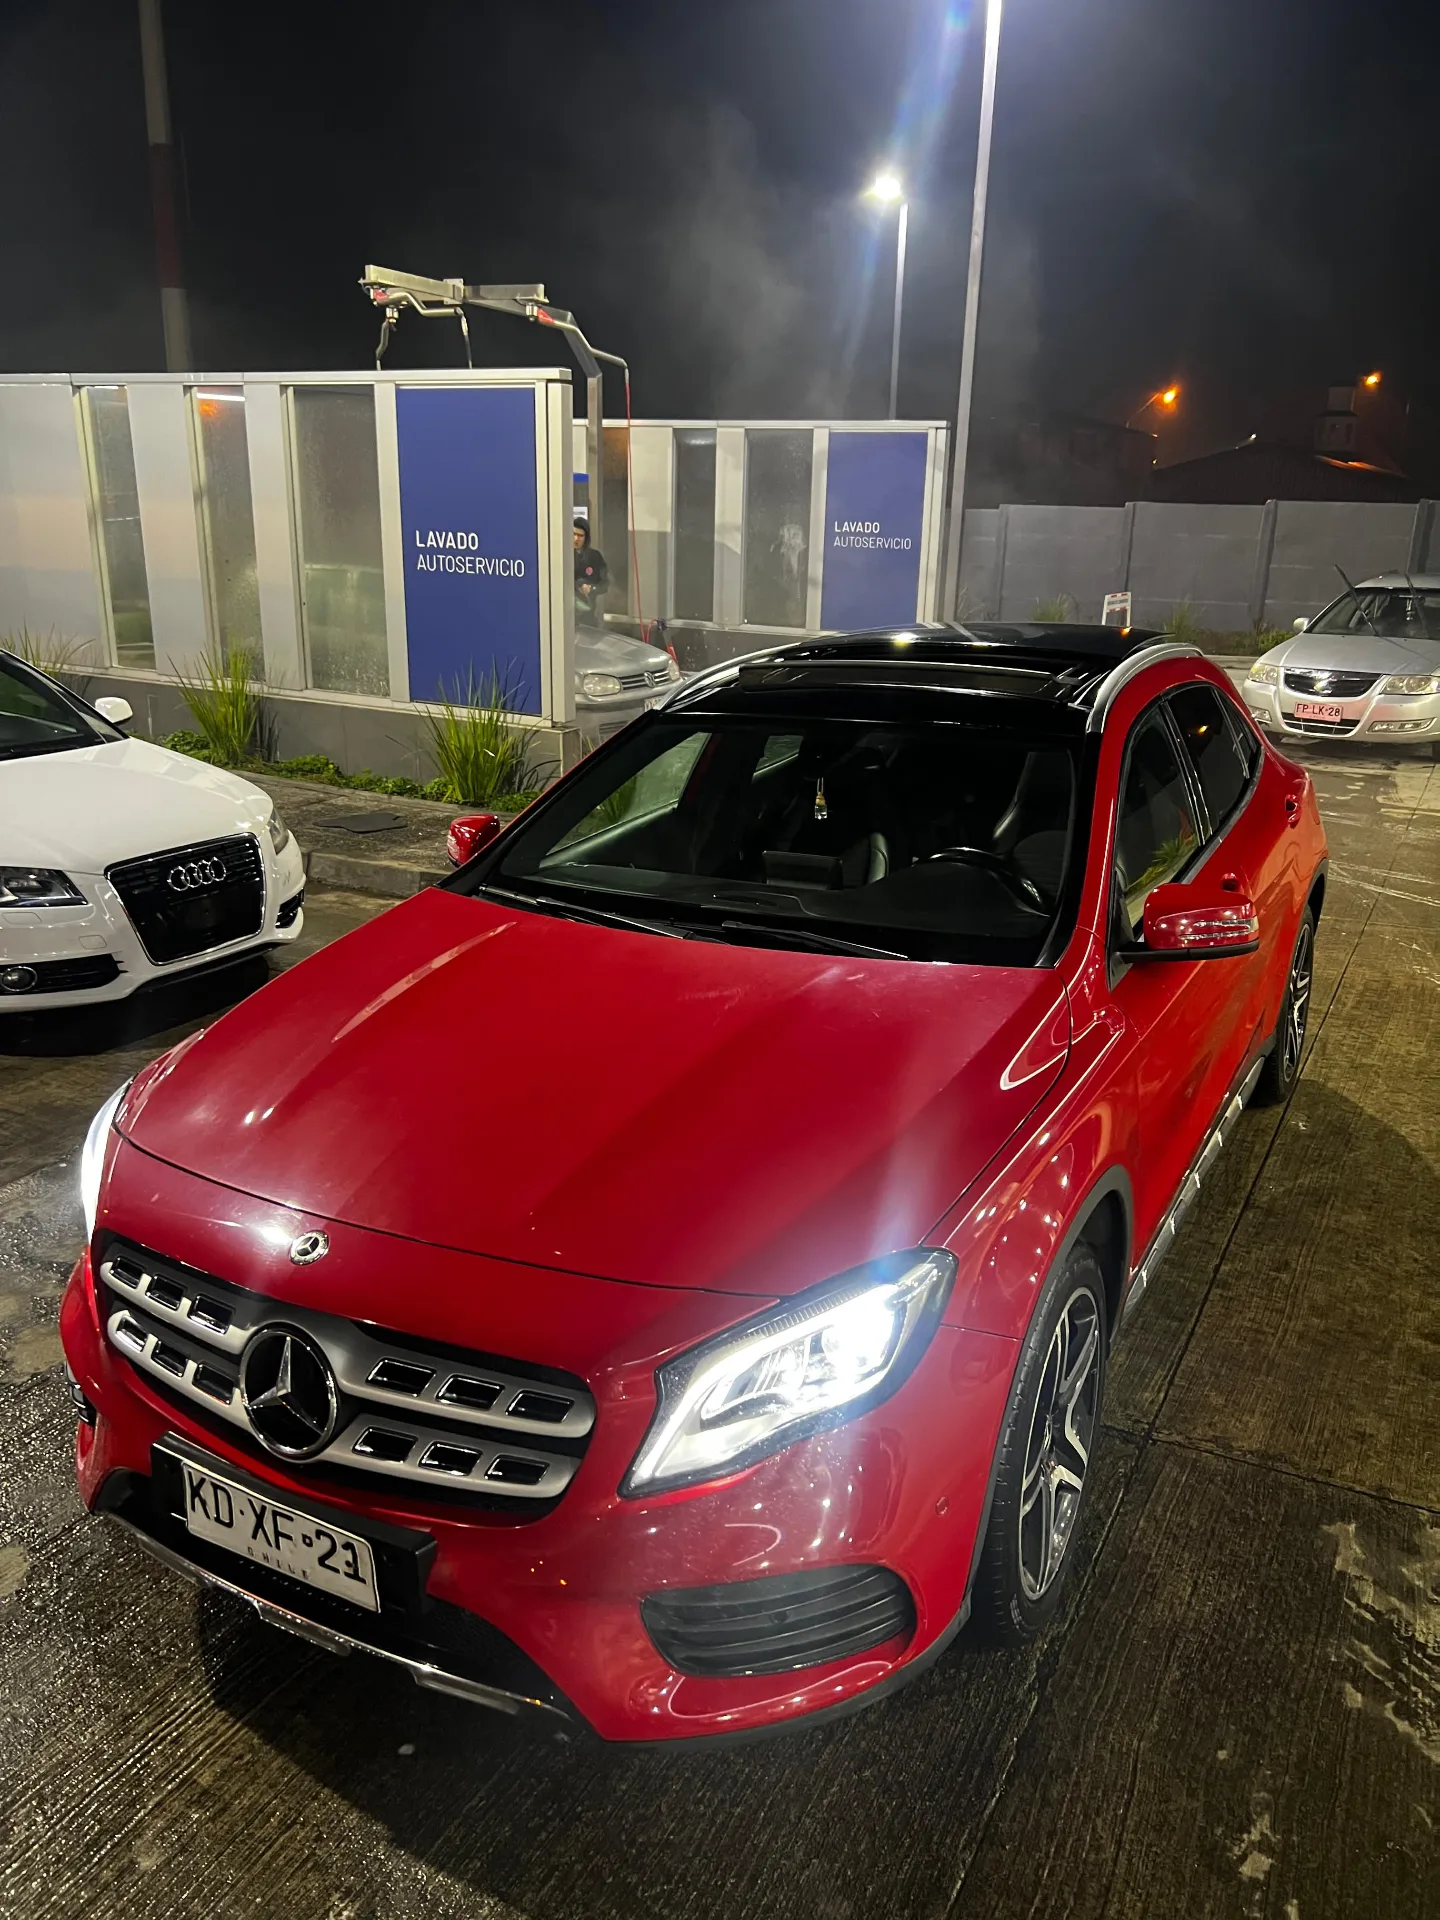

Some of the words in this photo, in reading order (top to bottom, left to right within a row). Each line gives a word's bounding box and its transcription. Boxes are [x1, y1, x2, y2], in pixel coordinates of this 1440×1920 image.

[834, 520, 880, 534] LAVADO
[415, 529, 479, 551] LAVADO
[833, 535, 912, 550] AUTOSERVICIO
[416, 553, 525, 578] AUTOSERVICIO
